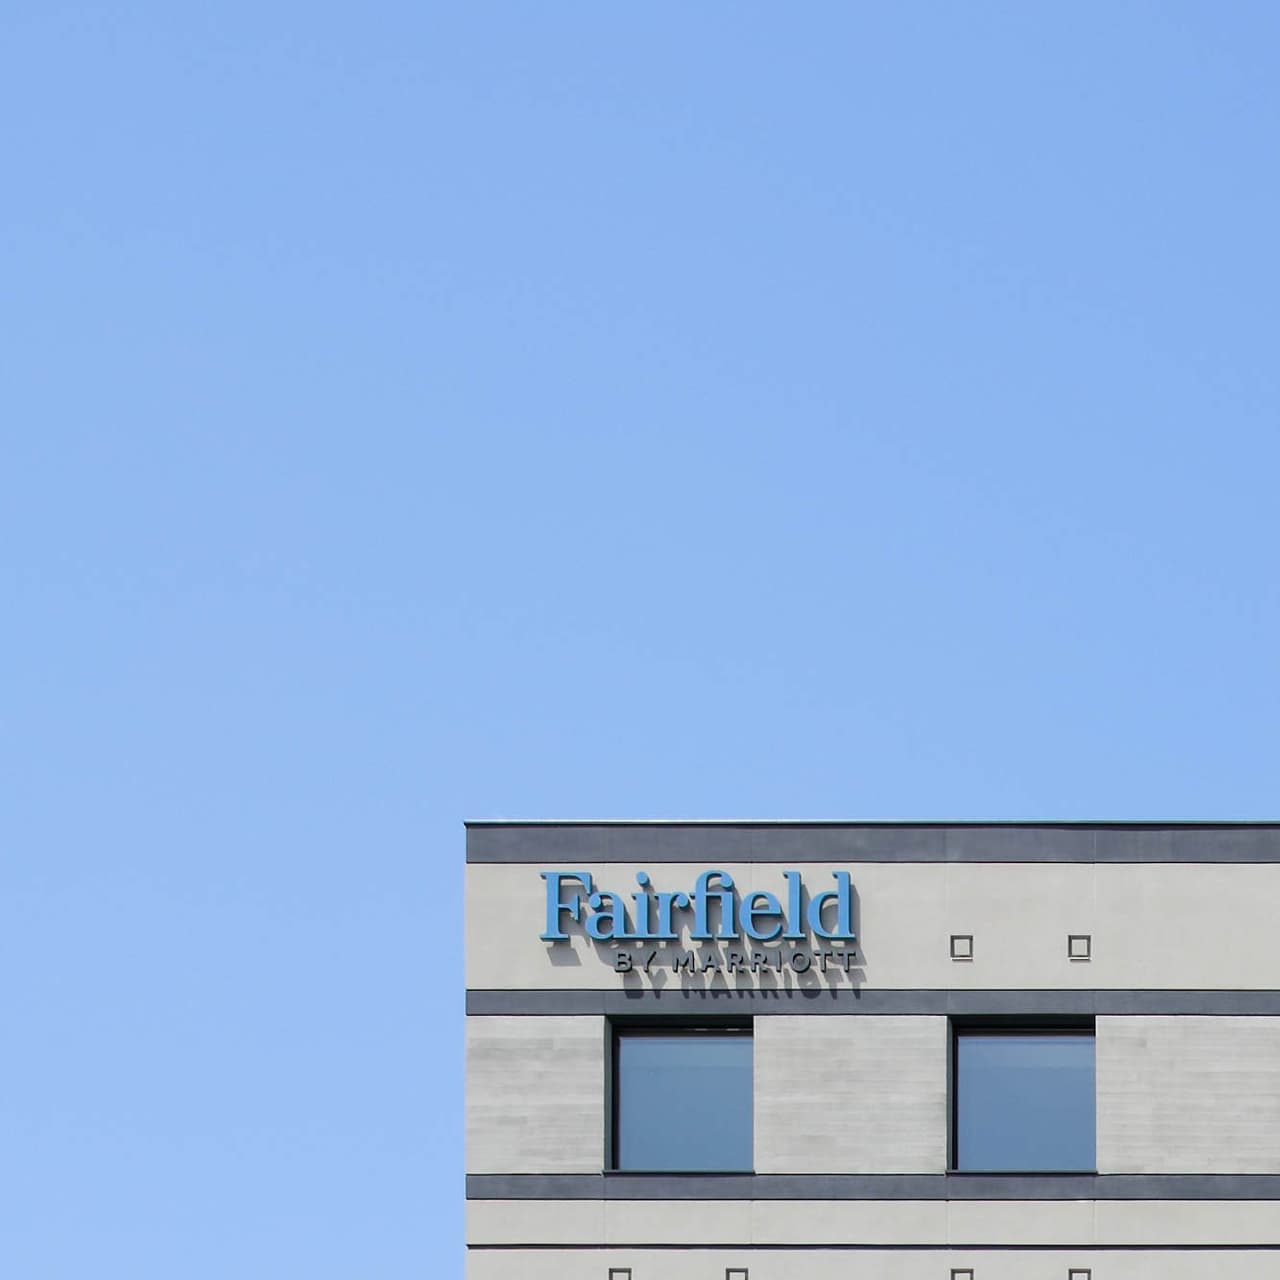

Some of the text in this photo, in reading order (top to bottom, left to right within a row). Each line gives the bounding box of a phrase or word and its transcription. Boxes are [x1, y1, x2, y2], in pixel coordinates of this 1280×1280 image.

[540, 870, 856, 942] Fairfield
[613, 950, 856, 973] BY MARRIOTT
